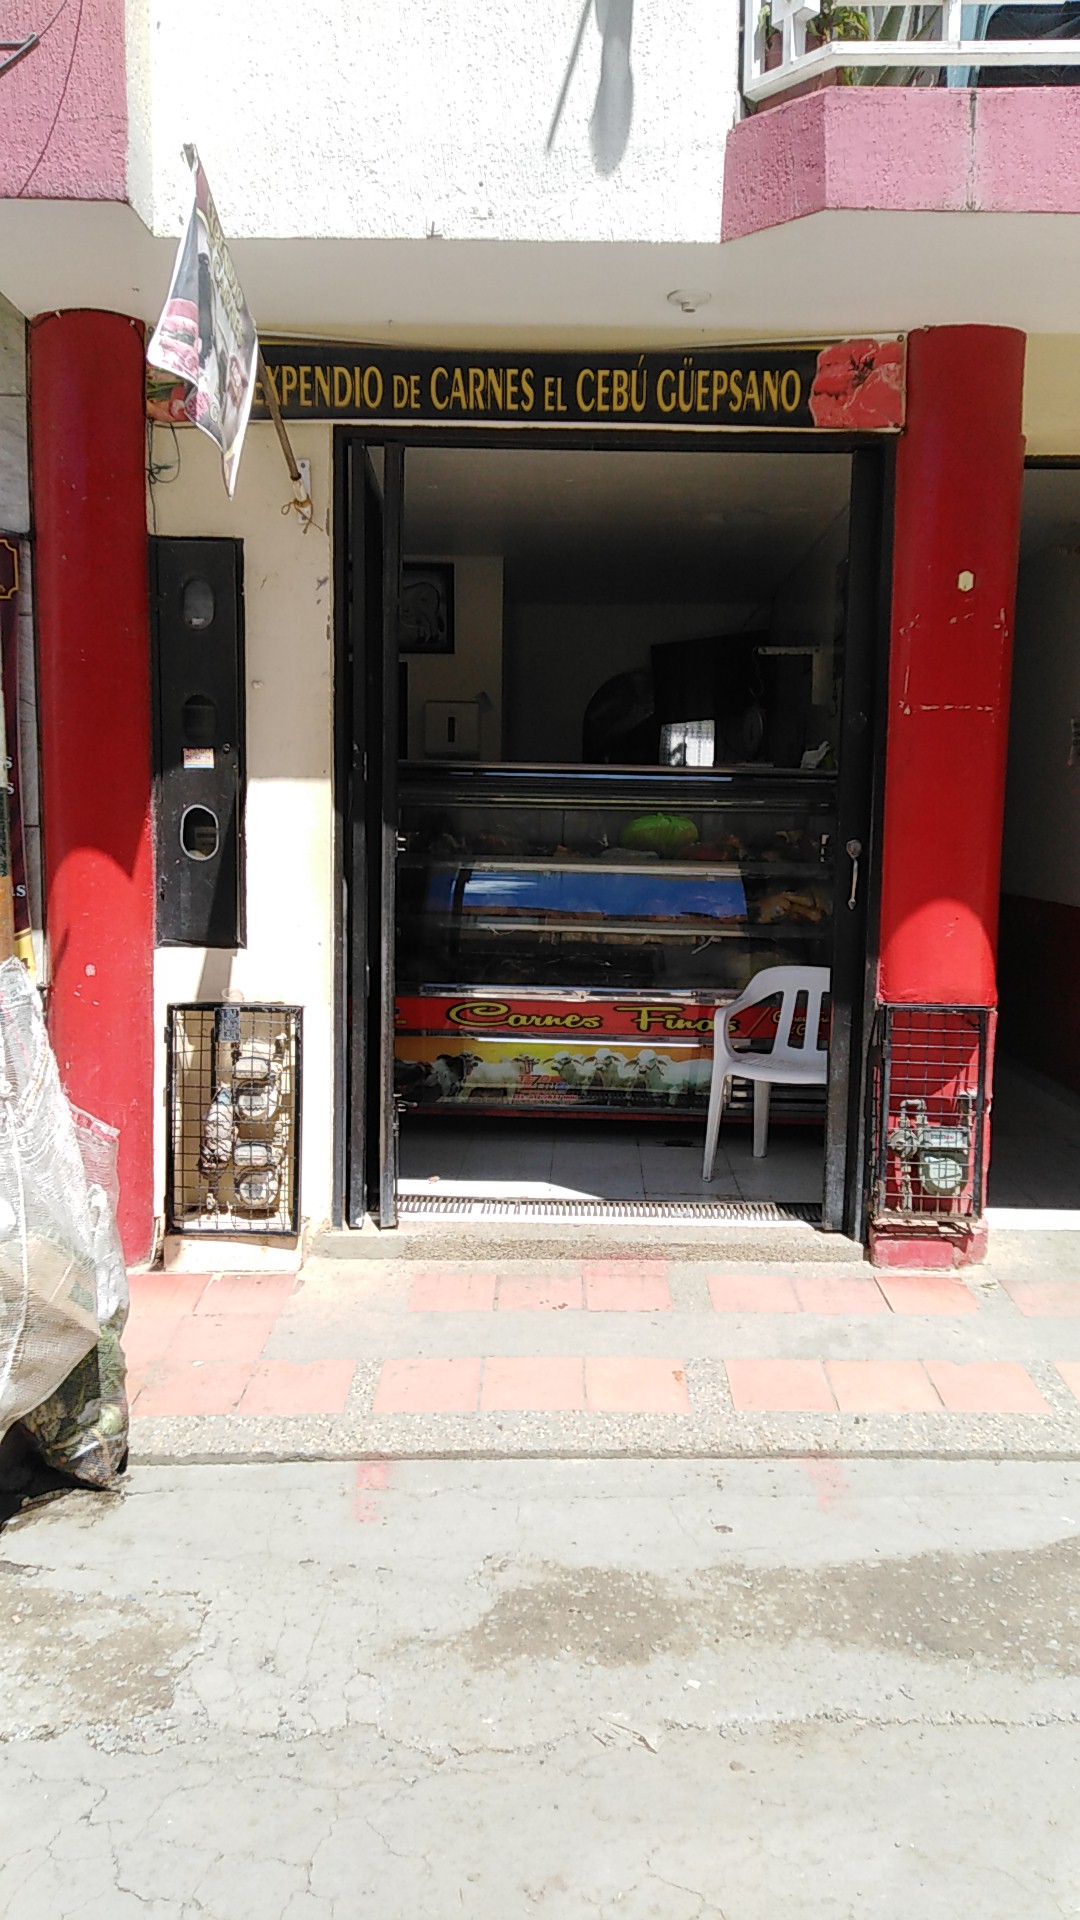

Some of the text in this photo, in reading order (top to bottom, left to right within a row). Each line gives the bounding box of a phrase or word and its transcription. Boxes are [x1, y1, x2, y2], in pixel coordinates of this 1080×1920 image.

[393, 375, 421, 409] DE
[430, 367, 535, 412] CARNES
[544, 377, 567, 411] EL
[576, 354, 647, 413] CEBÚ
[656, 357, 801, 413] GÜEPSANO
[449, 1002, 602, 1028] Carnes
